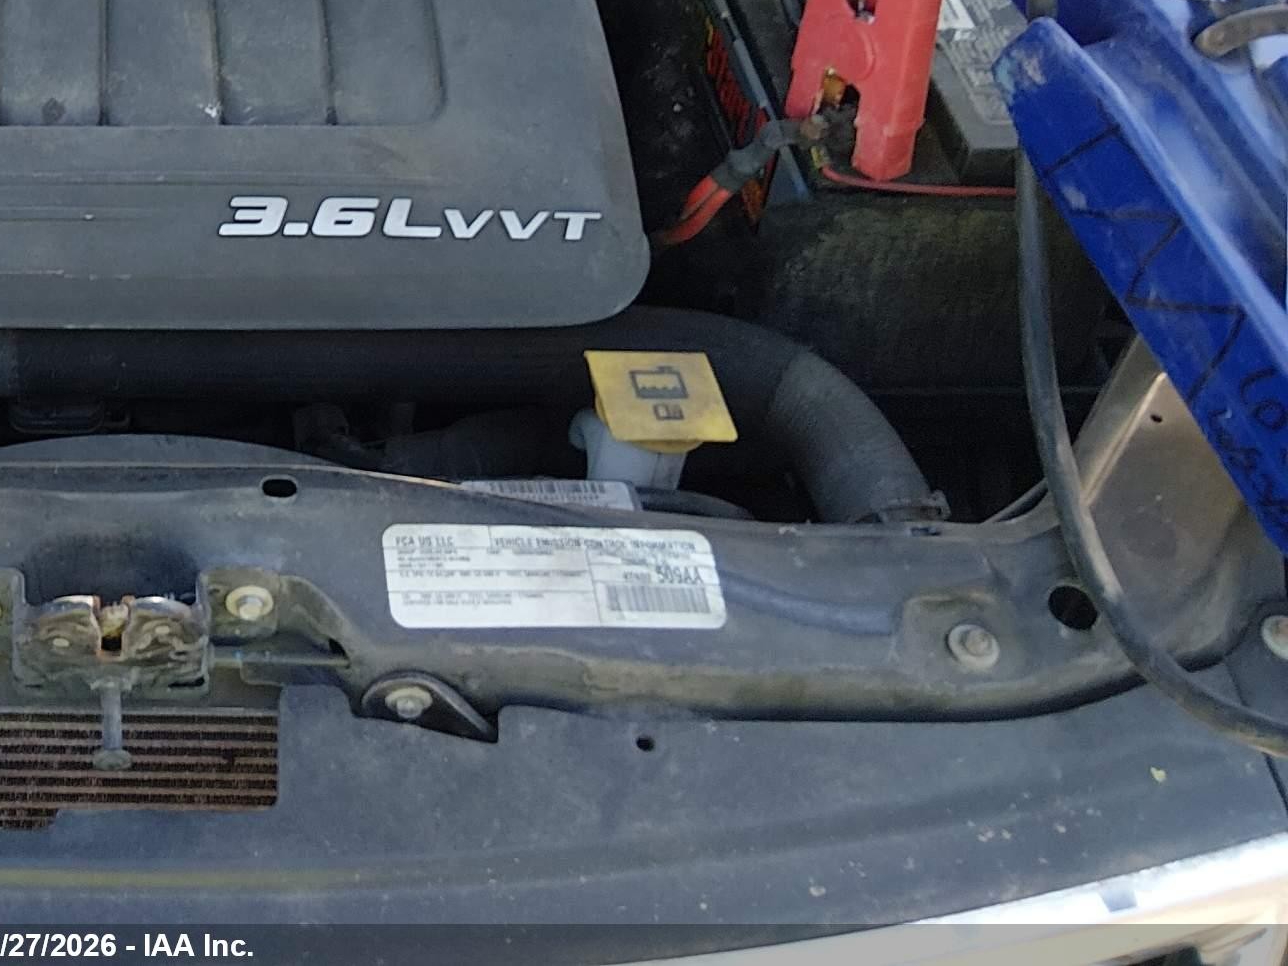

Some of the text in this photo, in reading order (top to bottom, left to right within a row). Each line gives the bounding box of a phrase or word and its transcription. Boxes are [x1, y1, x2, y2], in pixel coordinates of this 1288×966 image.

[396, 536, 415, 546] FCA
[435, 536, 454, 547] LLC
[494, 537, 695, 553] VEHICLE EMISSION CONTROL INFORMATION
